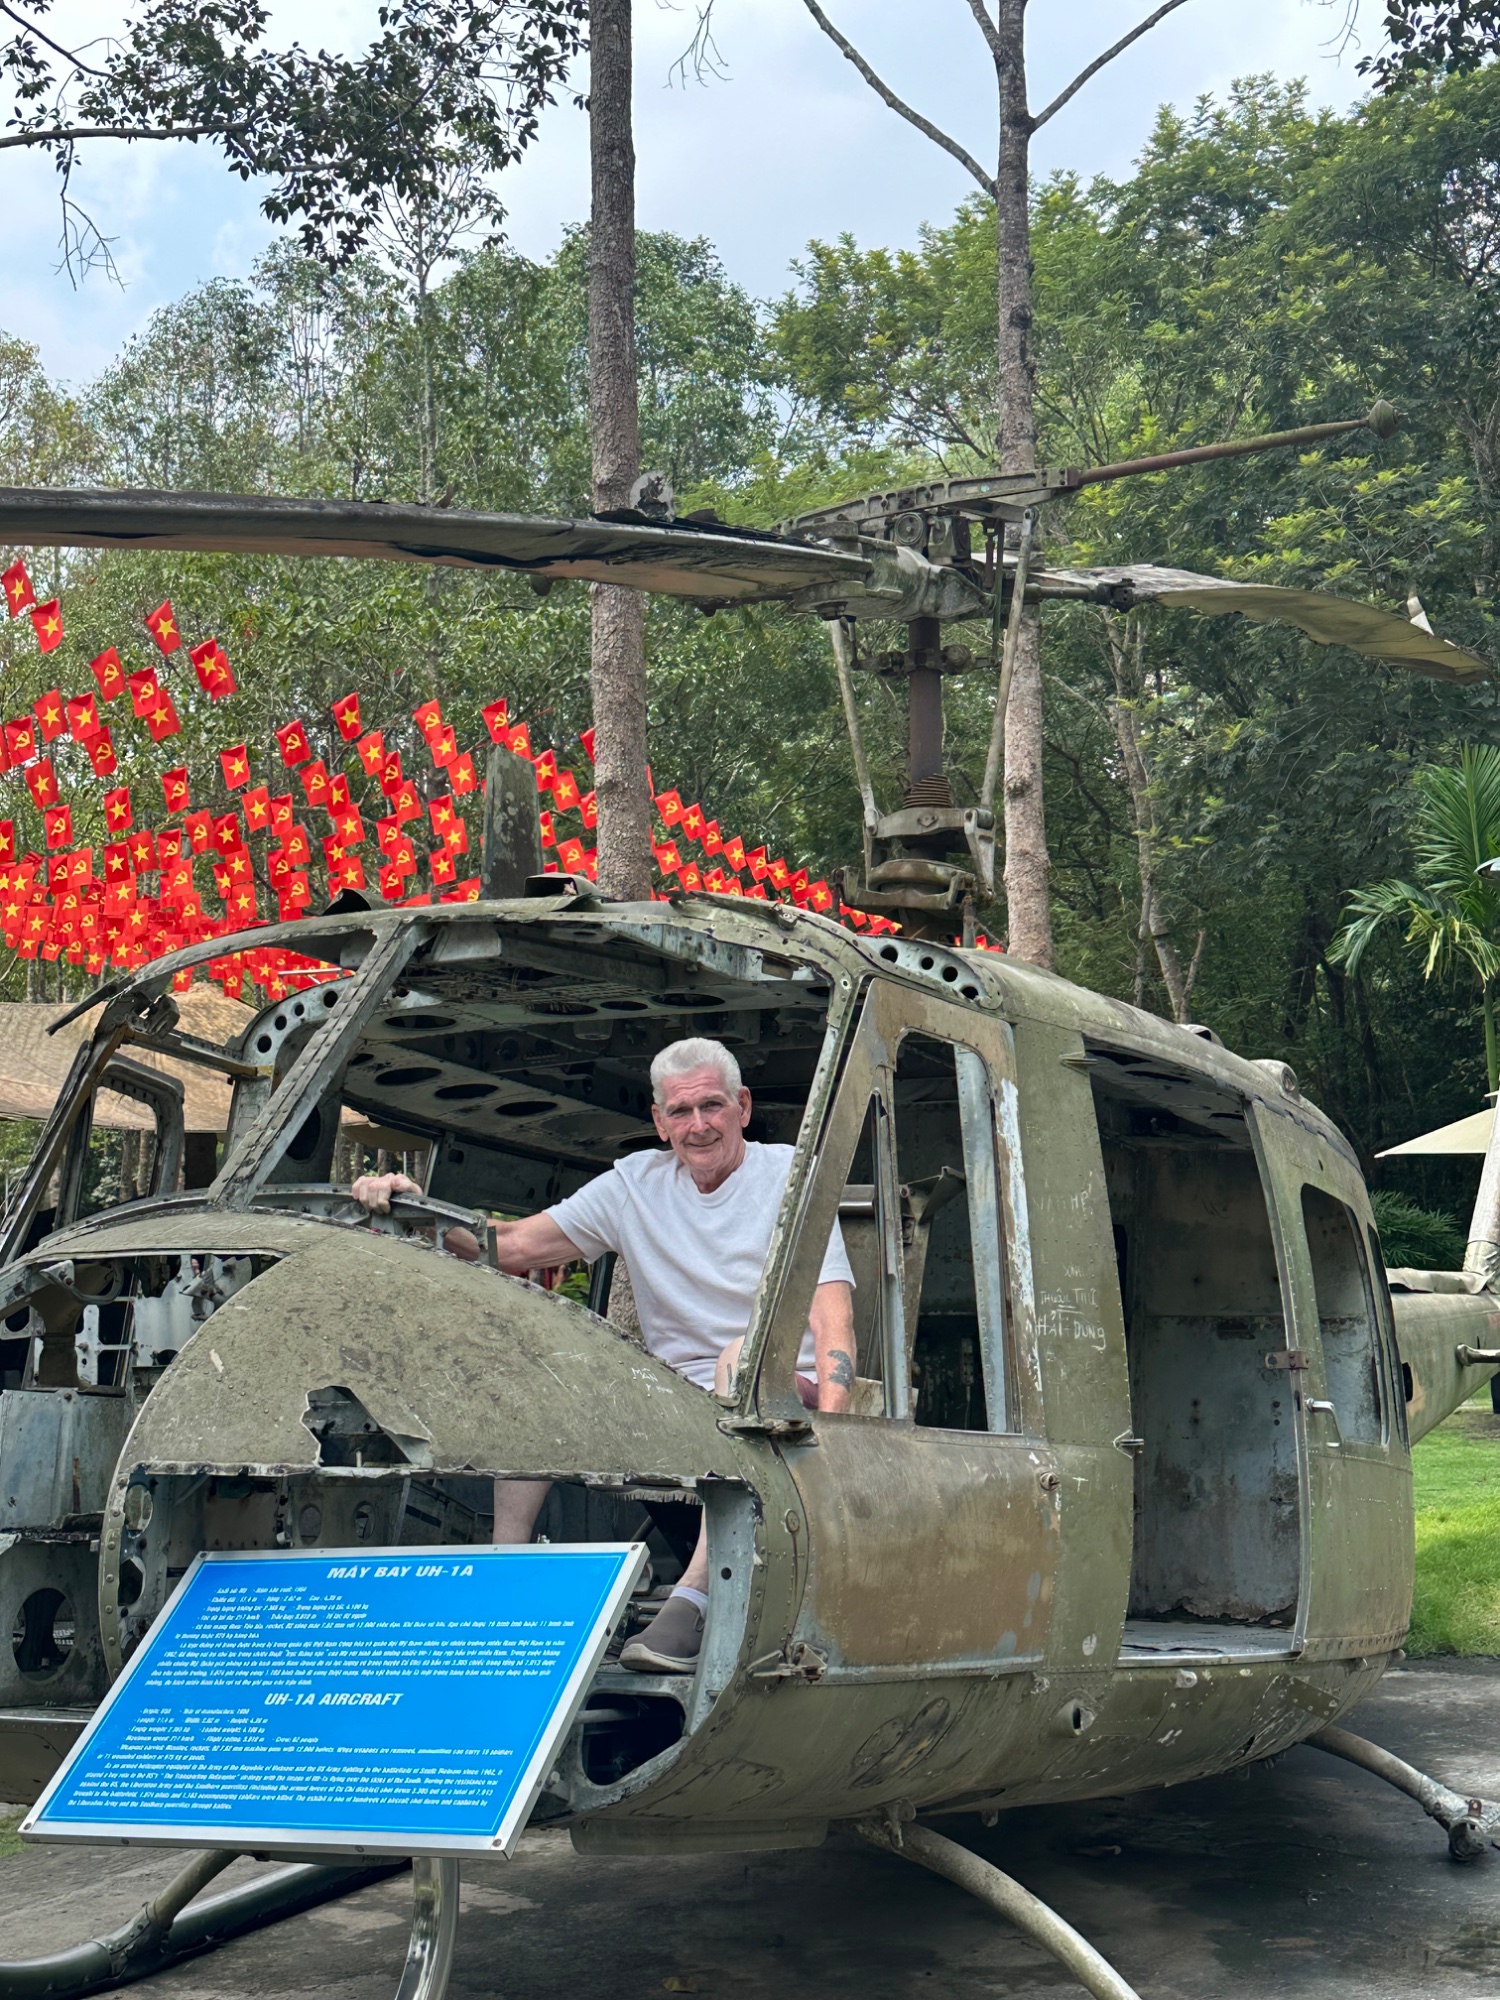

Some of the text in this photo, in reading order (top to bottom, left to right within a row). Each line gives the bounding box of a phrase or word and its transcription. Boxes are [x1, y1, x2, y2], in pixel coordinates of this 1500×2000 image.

[327, 1565, 474, 1579] MÁY BAY UH-1A
[264, 1693, 404, 1706] UH-1A AIRCRAFT
